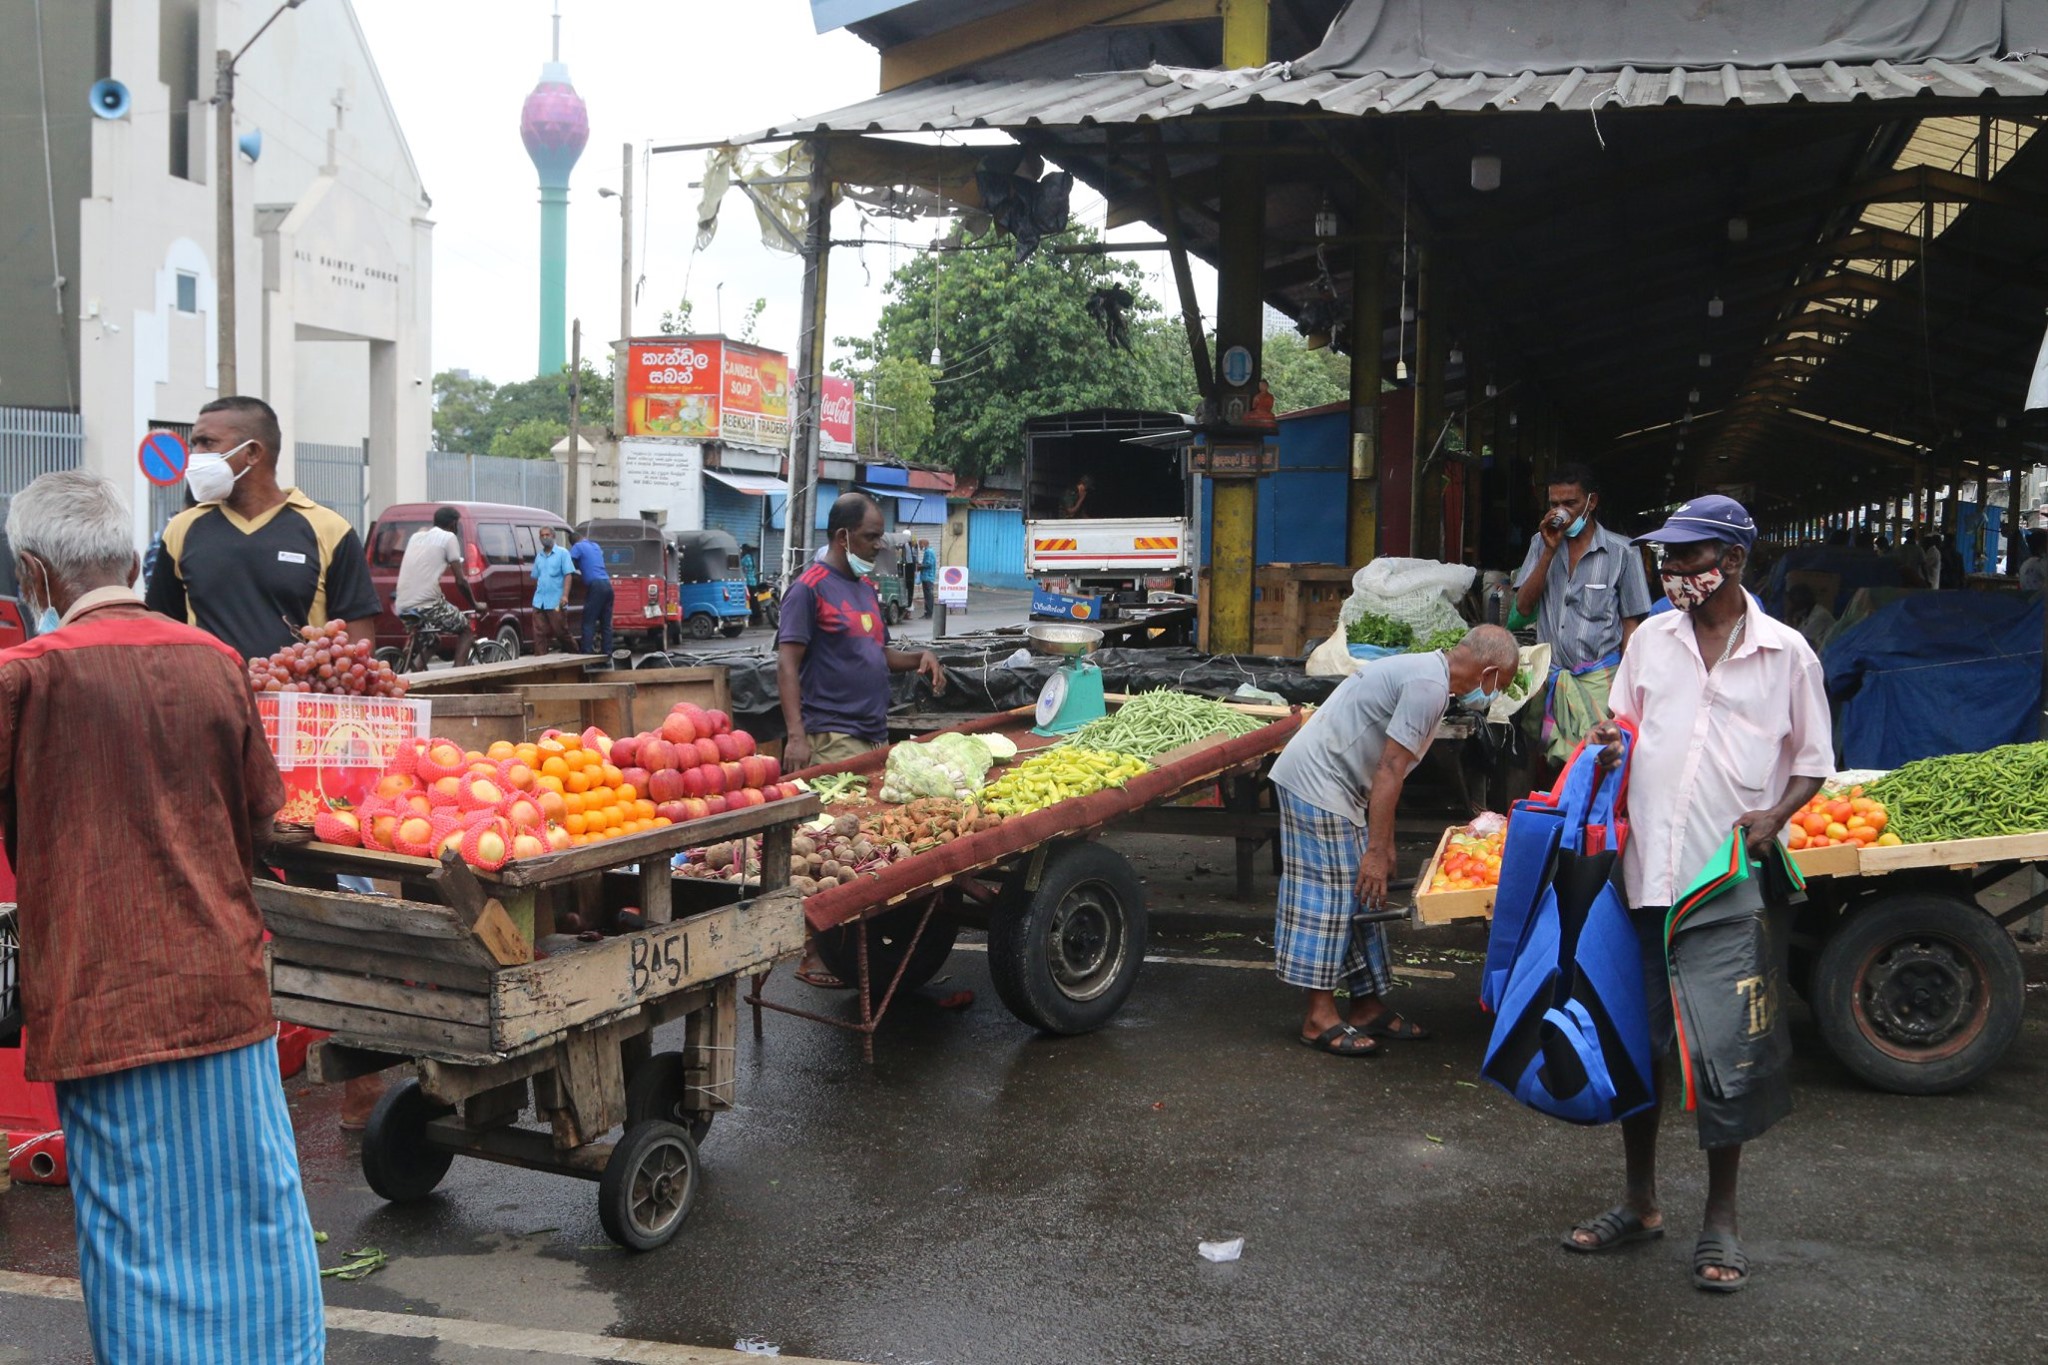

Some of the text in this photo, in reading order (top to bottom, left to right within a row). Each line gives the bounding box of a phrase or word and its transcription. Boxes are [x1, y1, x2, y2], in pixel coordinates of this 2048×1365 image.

[294, 249, 311, 262] ALL
[365, 267, 398, 284] CHURCH
[331, 275, 365, 290] PETTAH
[724, 361, 759, 381] CANDELA
[731, 381, 752, 397] SOAP
[757, 420, 788, 436] TRADERS
